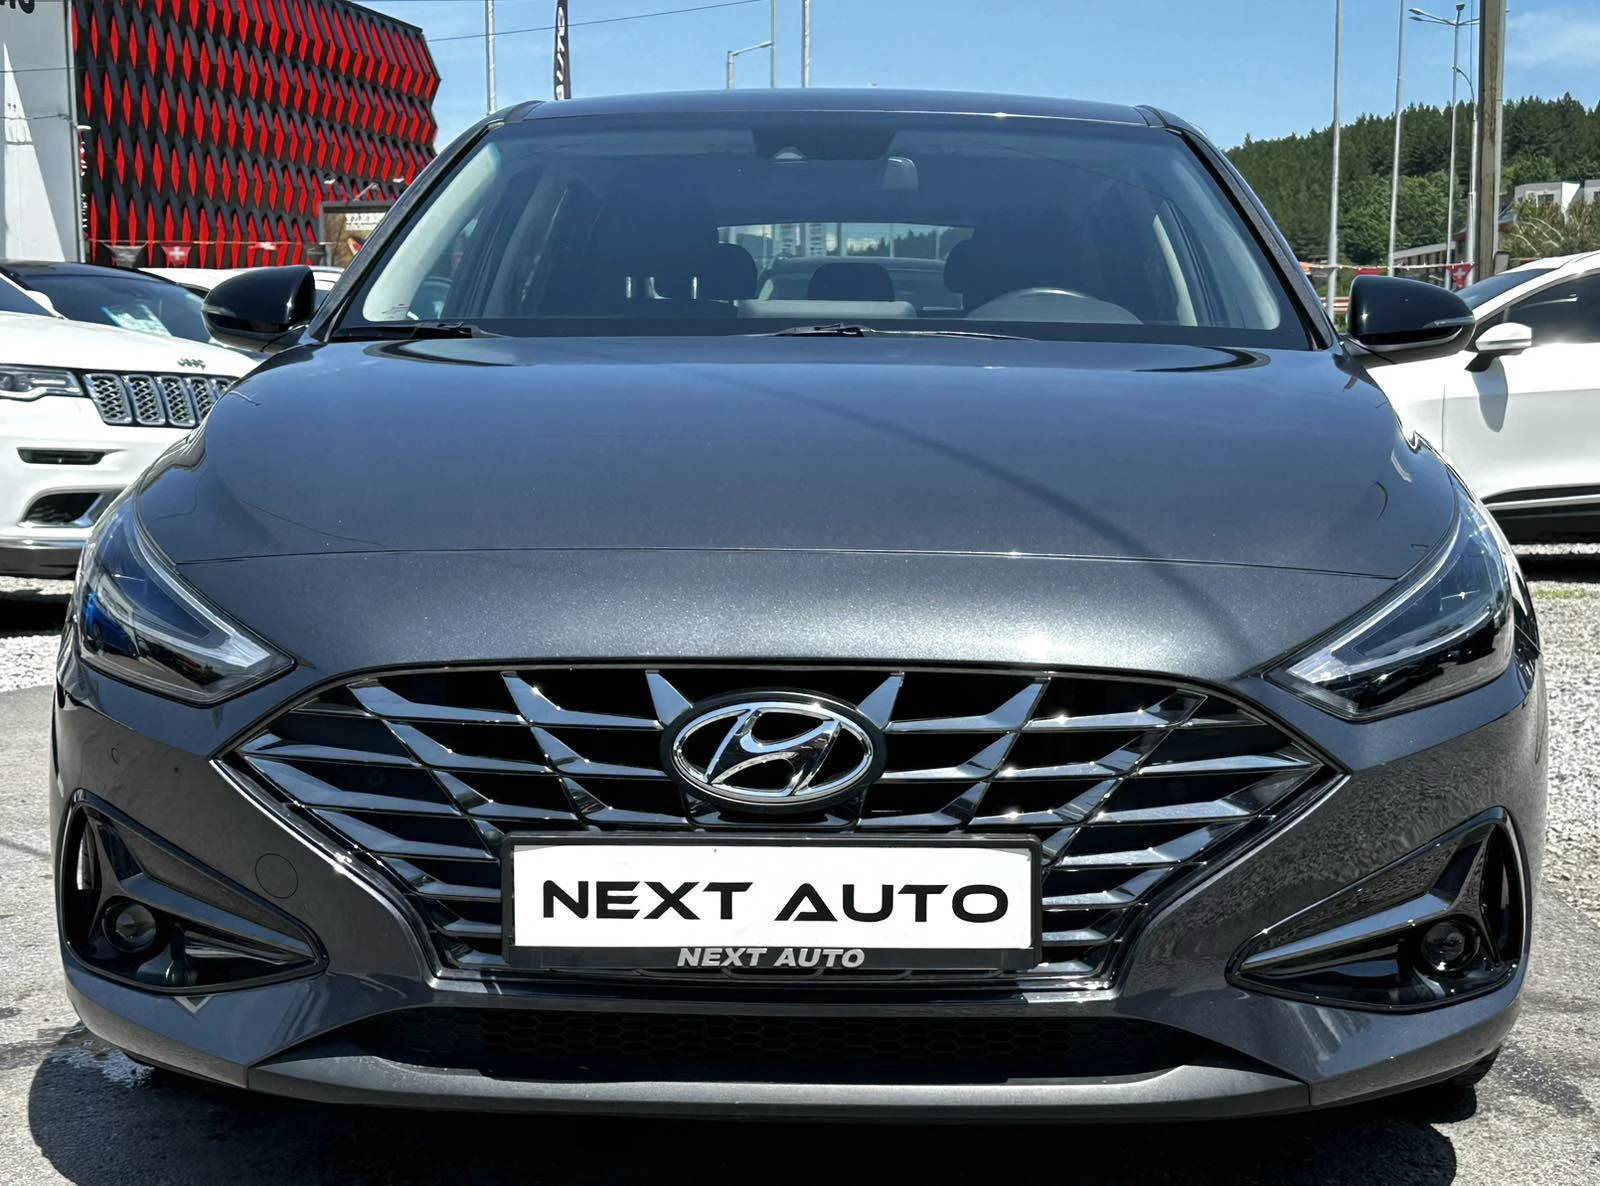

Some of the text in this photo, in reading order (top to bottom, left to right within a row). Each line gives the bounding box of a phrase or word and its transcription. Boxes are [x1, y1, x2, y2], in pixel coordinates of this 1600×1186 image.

[542, 879, 1009, 924] NEXT AUTO
[676, 947, 866, 968] NEXT AUTO
